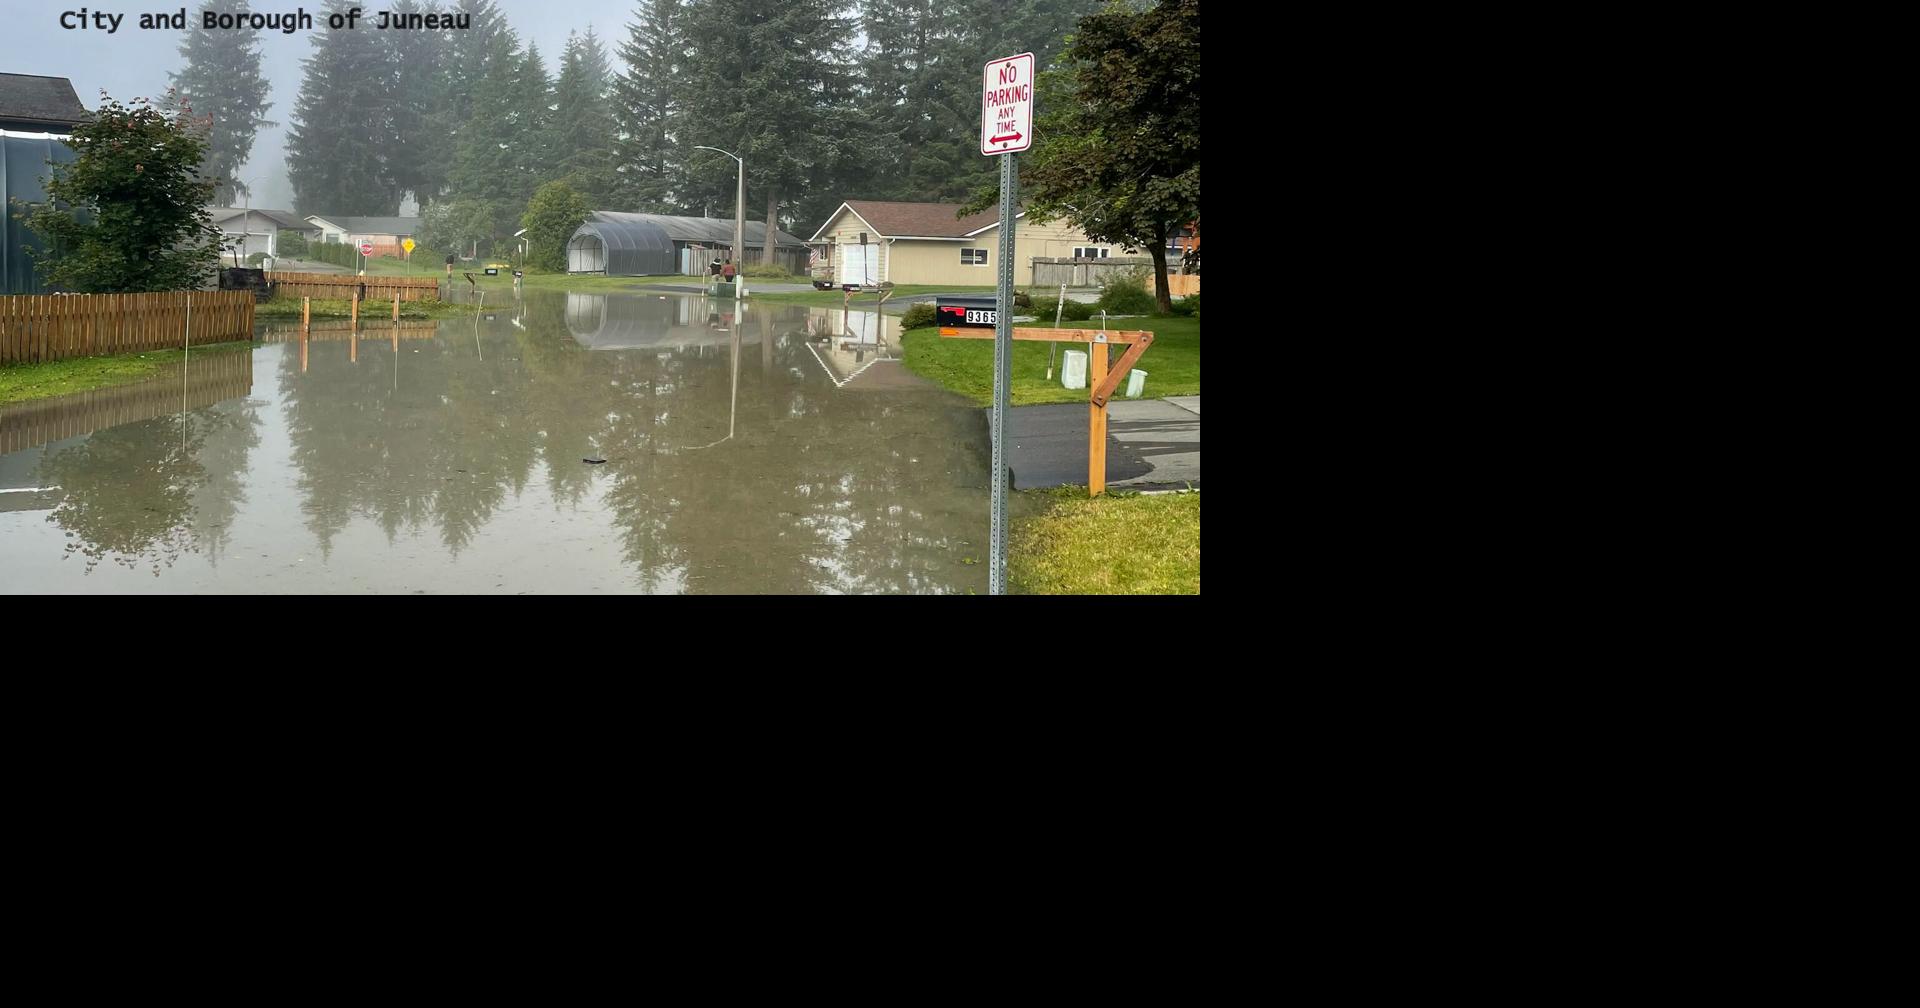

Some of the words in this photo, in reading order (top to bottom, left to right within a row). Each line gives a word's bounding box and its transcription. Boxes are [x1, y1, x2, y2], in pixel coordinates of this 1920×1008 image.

[1000, 66, 1017, 85] NO
[987, 84, 1028, 108] PARKING
[998, 106, 1016, 120] ANY
[997, 120, 1016, 135] TIME
[967, 311, 997, 323] 9365
